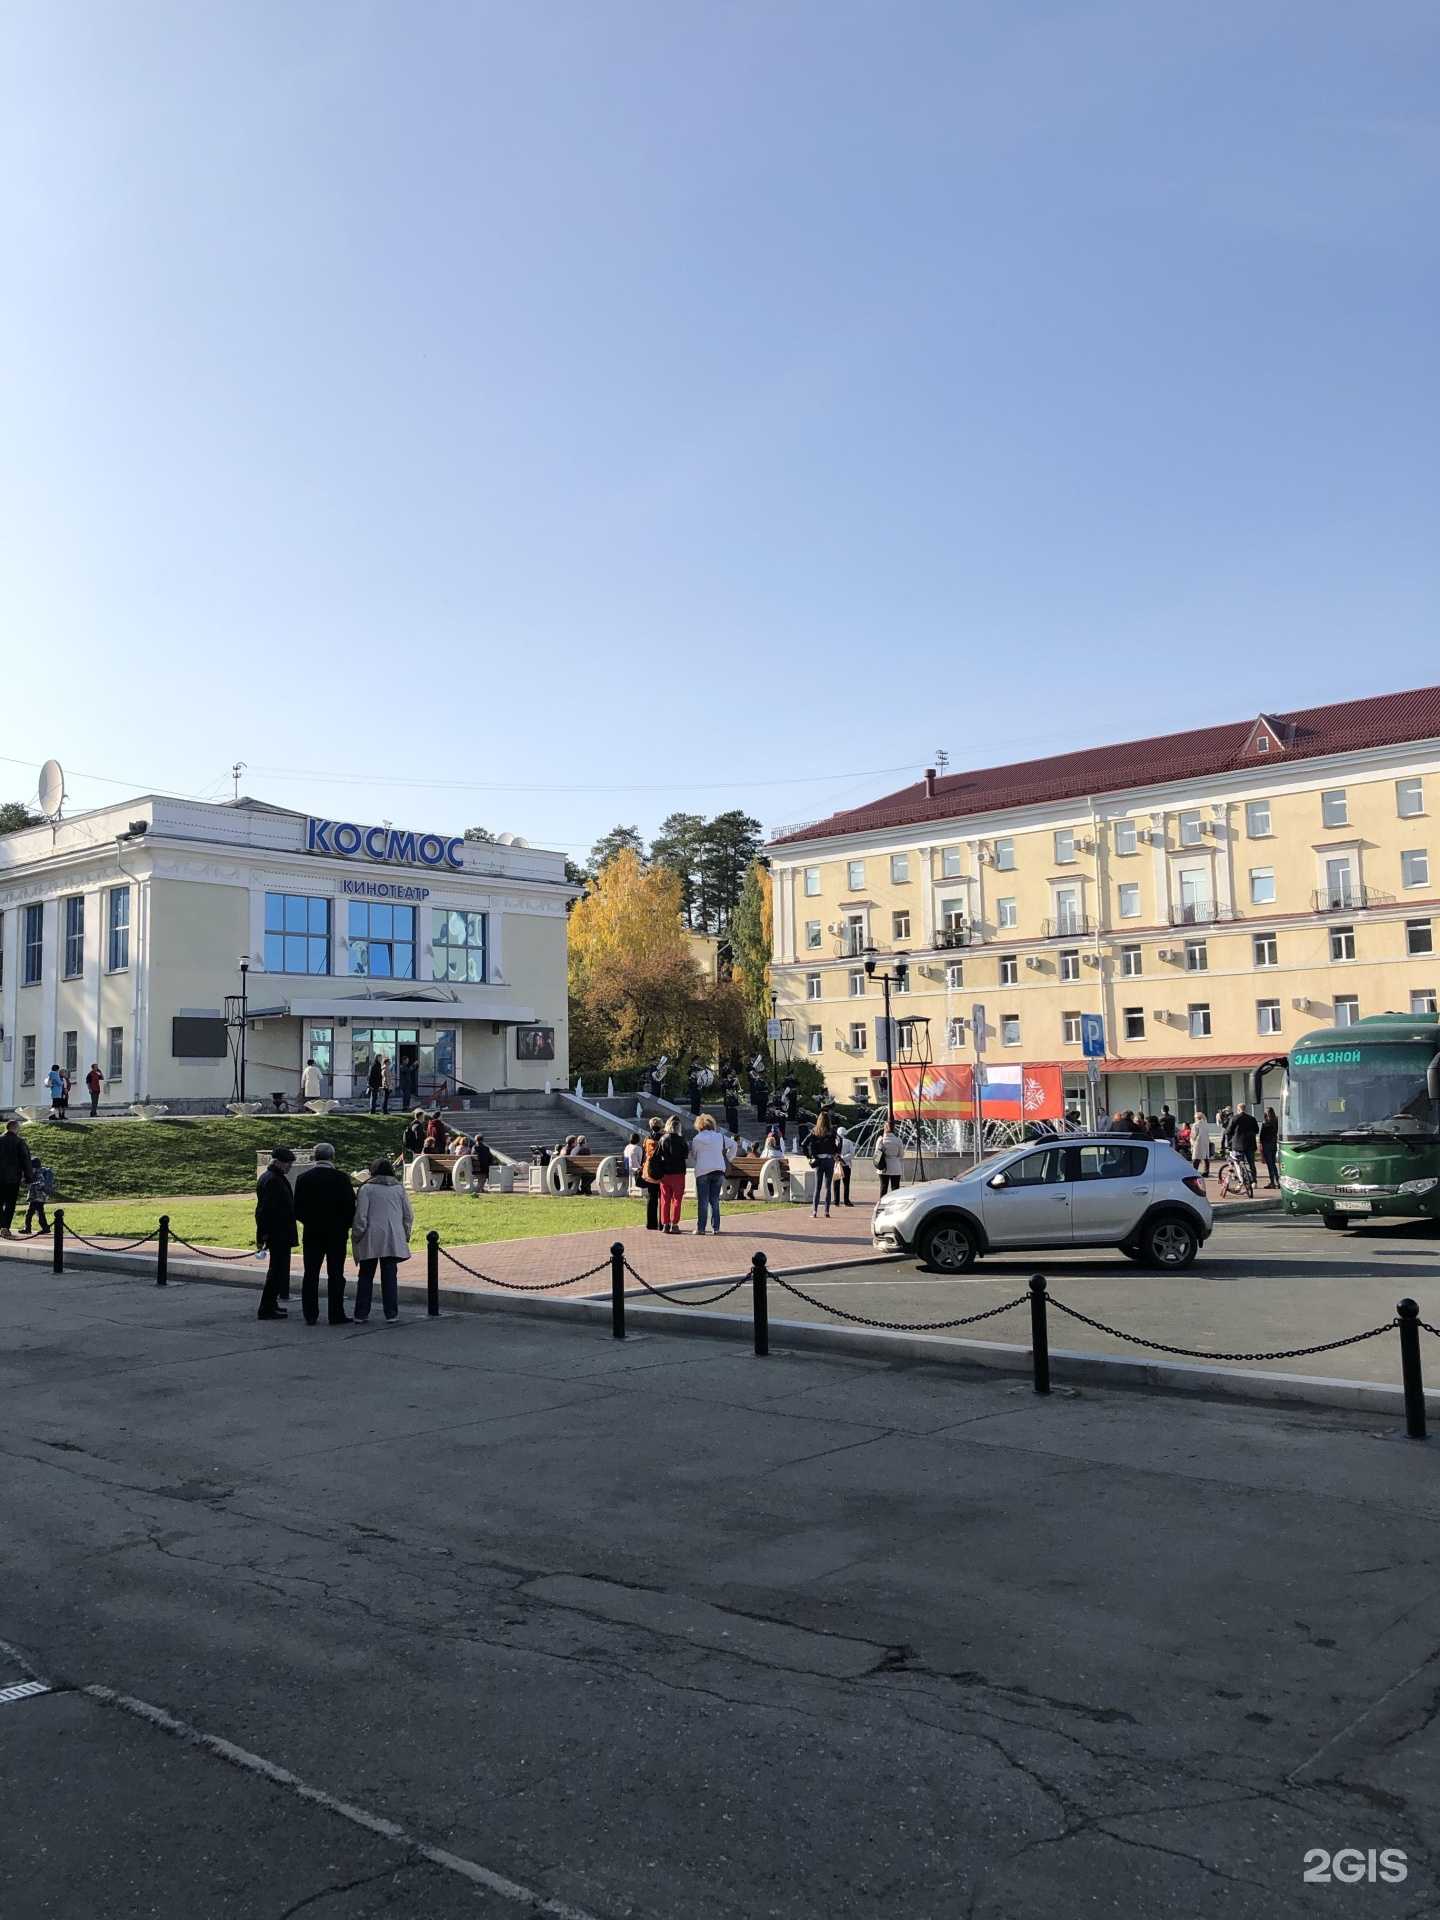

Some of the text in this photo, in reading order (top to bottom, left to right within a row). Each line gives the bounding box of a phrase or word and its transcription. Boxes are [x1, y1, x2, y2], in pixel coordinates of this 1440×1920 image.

[307, 819, 465, 868] КОСМОС
[343, 879, 429, 901] КИНОТЕАТР
[1295, 1048, 1361, 1065] ЗАКАЗНОЙ
